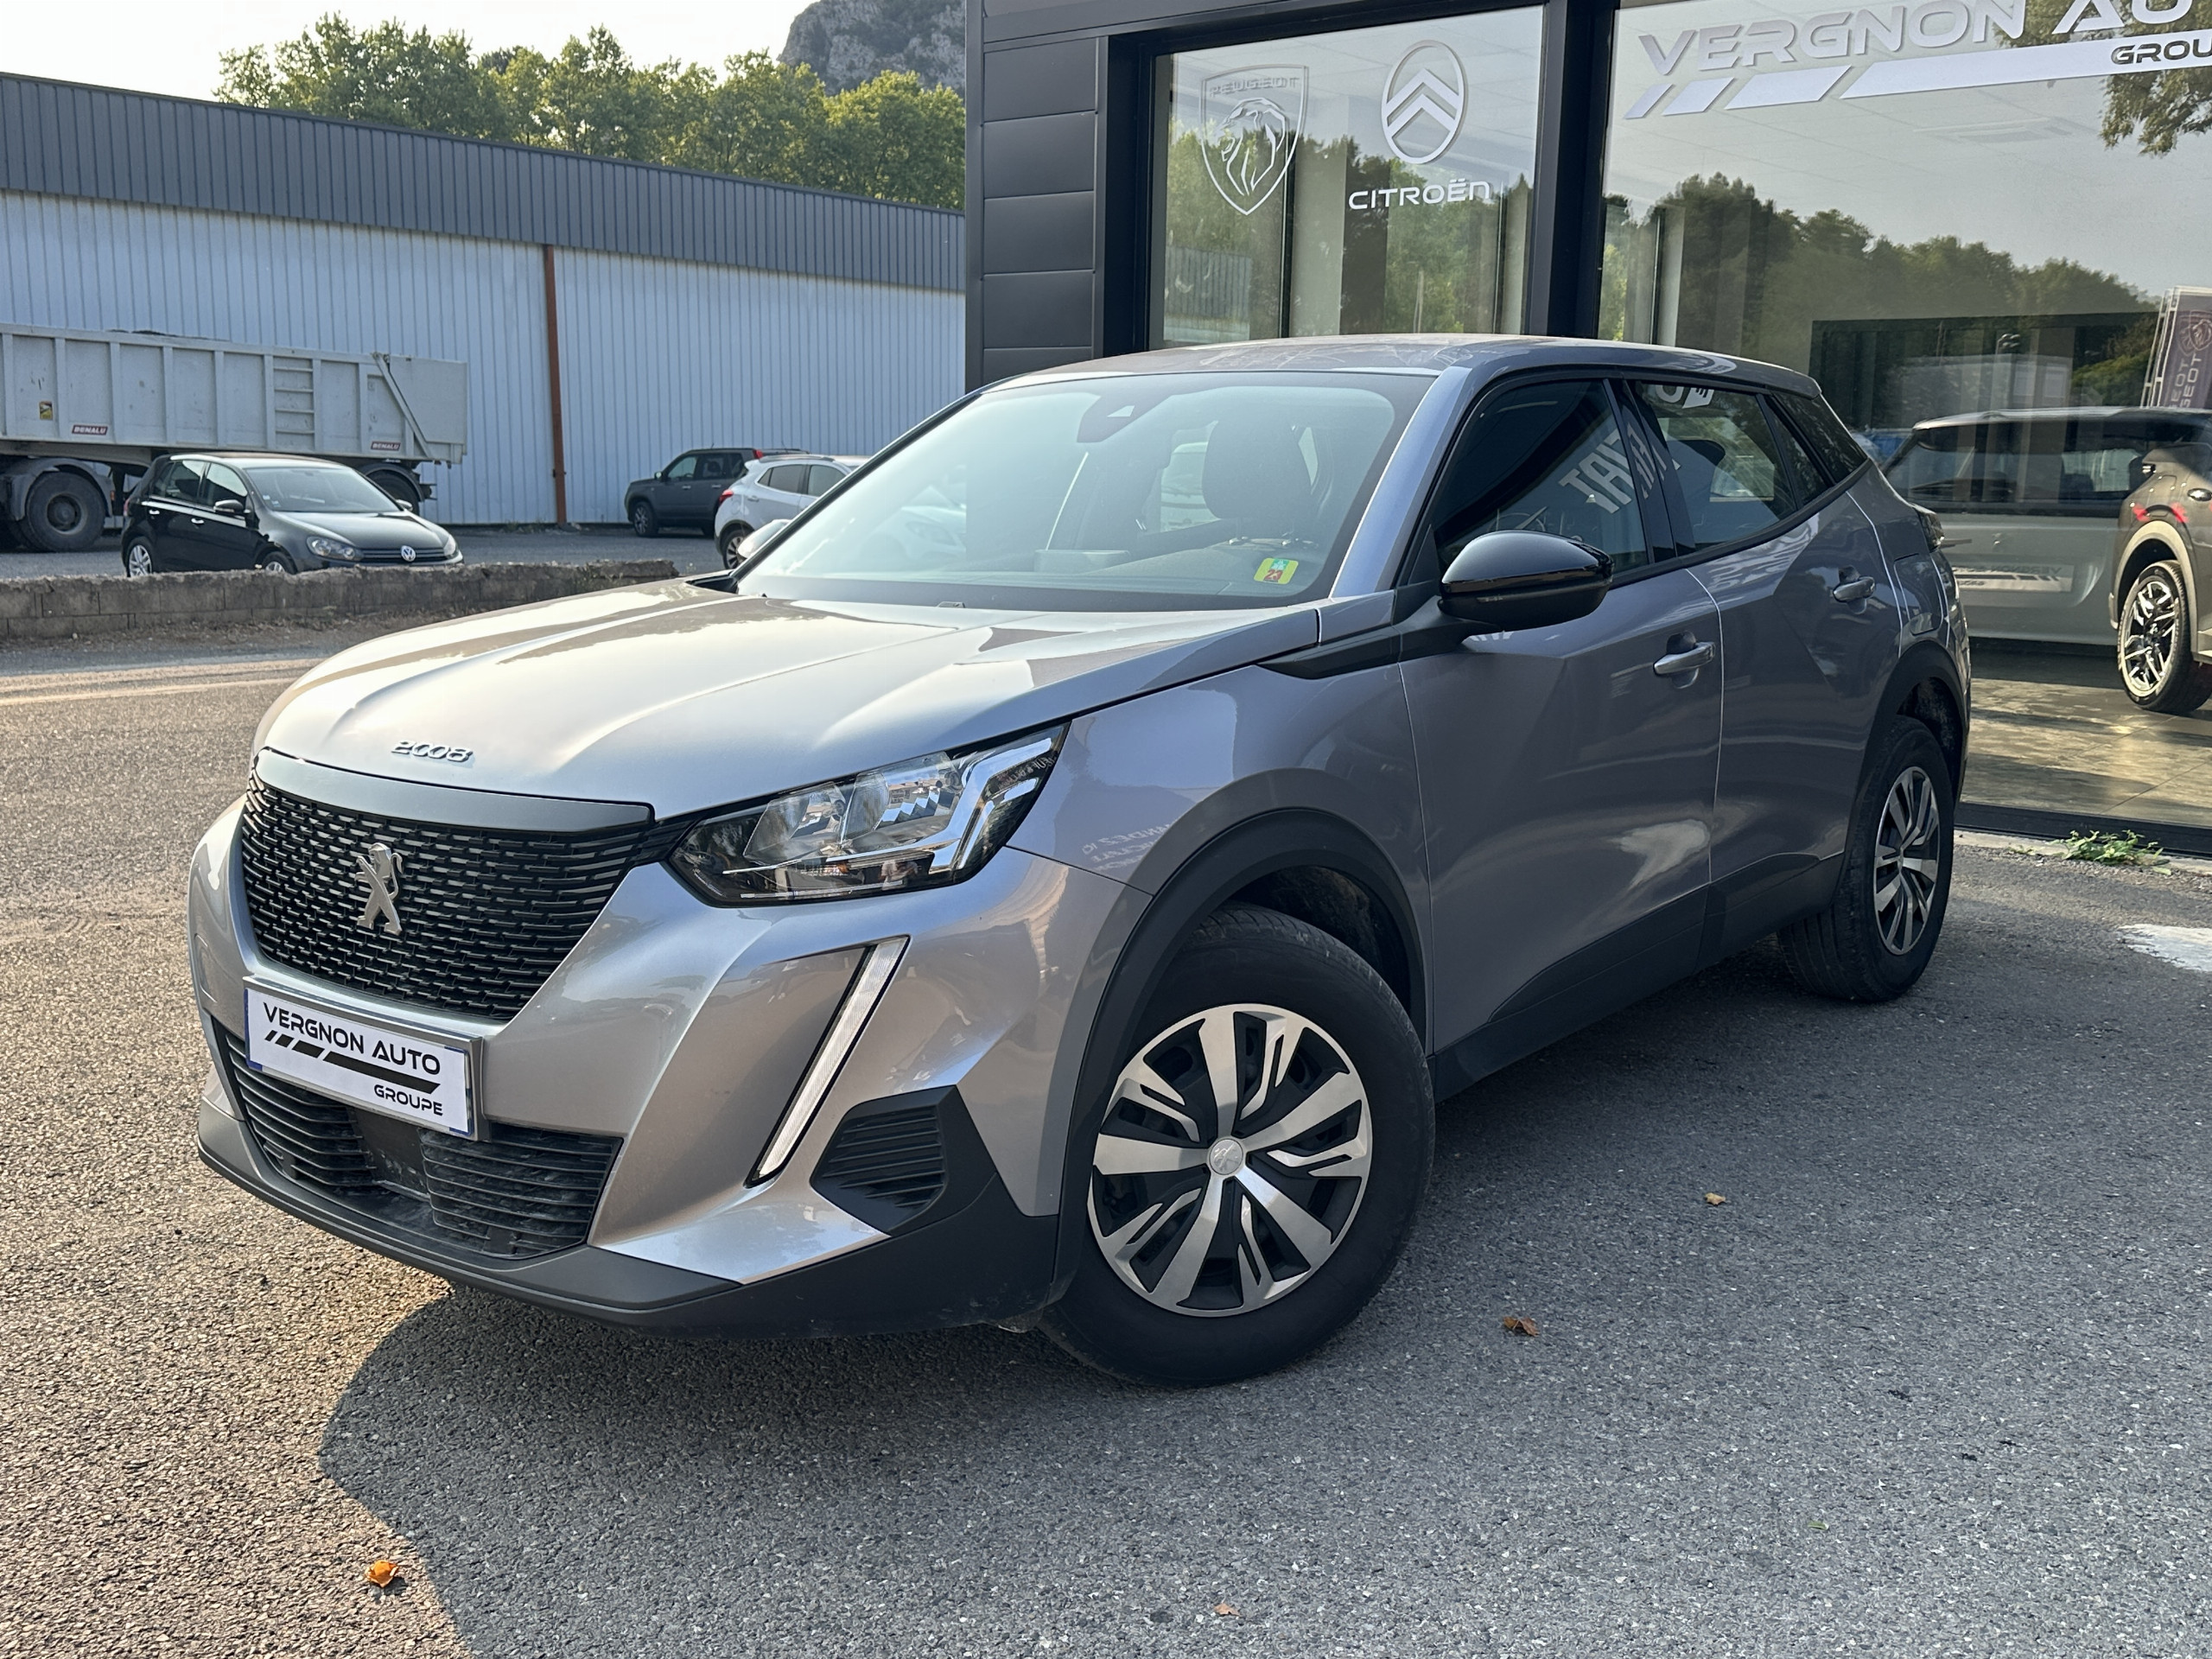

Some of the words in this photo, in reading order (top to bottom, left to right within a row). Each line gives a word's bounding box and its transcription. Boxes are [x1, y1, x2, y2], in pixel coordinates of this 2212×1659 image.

[1638, 0, 2026, 76] VERGNON
[1210, 77, 1300, 97] PEUGEOT
[391, 741, 474, 762] 2008
[263, 1001, 364, 1054] VERGNON
[372, 1039, 441, 1075] AUTO
[373, 1084, 443, 1116] GROUPE
